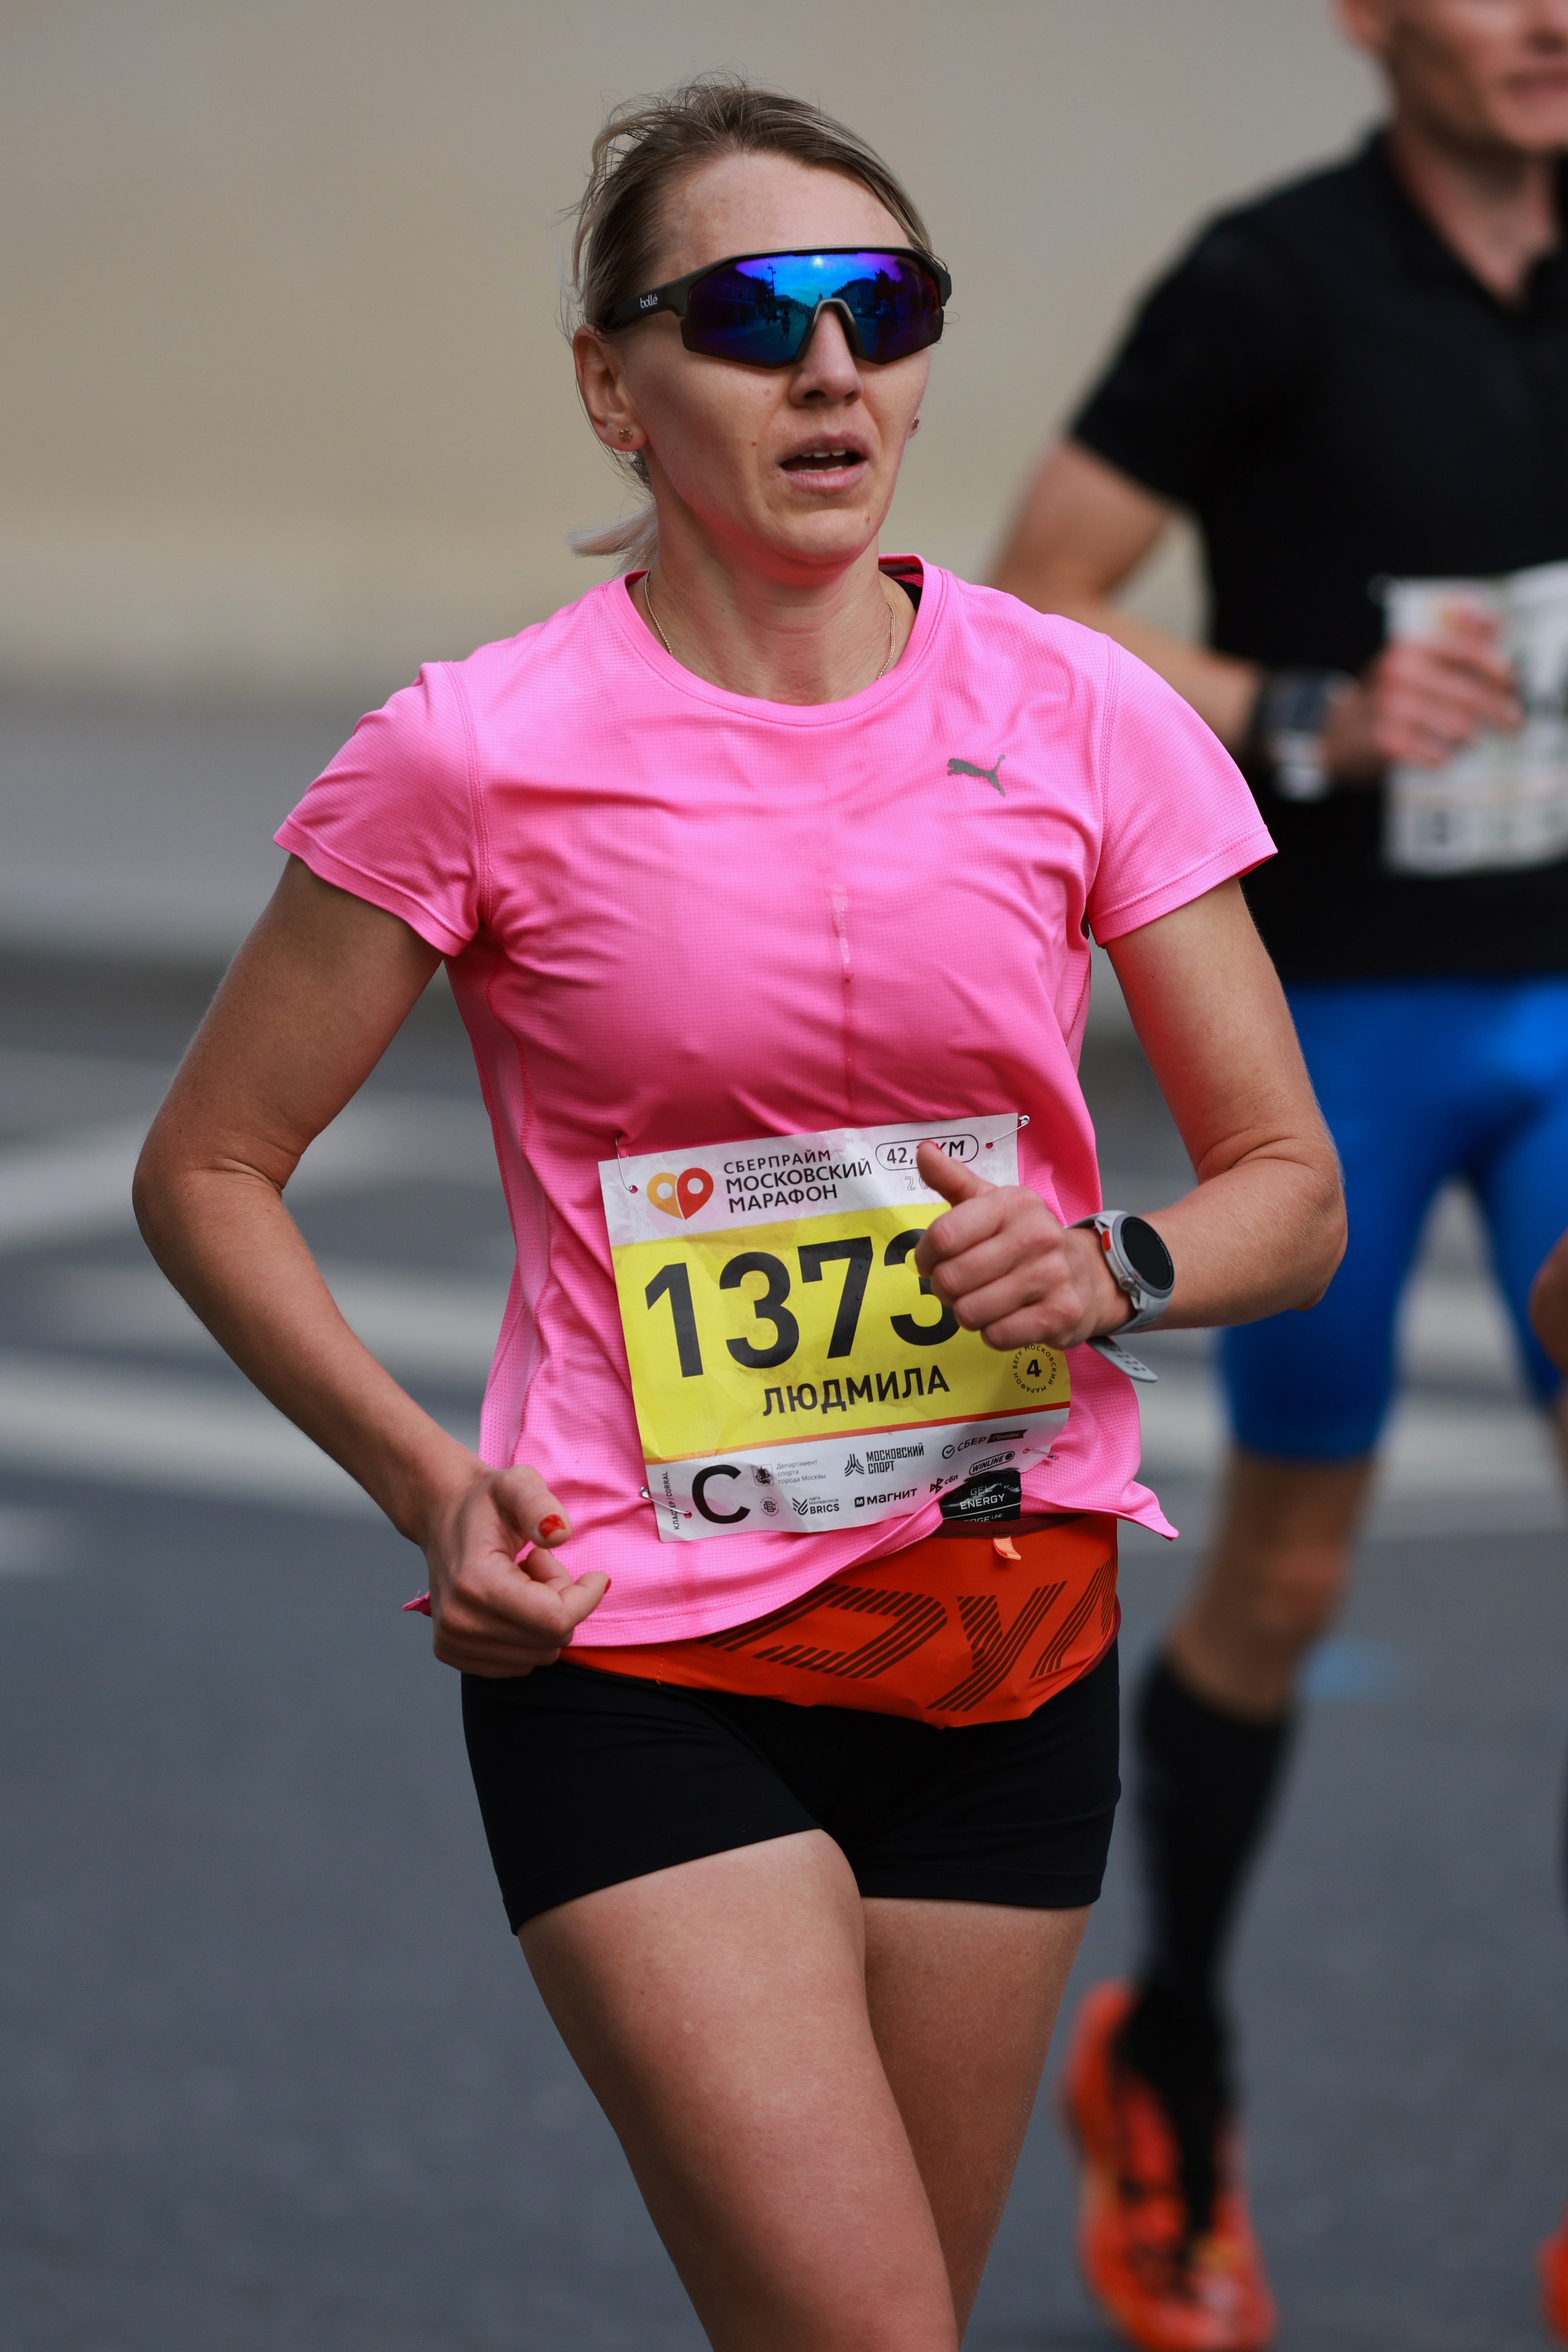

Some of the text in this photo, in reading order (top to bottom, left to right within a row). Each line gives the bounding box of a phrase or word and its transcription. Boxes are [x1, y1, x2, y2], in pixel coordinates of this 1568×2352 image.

[723, 1149, 831, 1174] СБЕРПРАЙМ
[886, 1145, 919, 1165] 42,
[726, 1157, 873, 1194] МОСКОВСКИЙ
[729, 1184, 838, 1213] МАРАФОН
[1024, 1344, 1057, 1385] МОСКОВСКИЙ
[1026, 1359, 1042, 1378] 4
[762, 1364, 950, 1417] ЛЮДМИЛА
[1013, 1373, 1046, 1393] МАРАФОН
[866, 1442, 924, 1463] МОСКОВСКИЙ
[957, 1436, 987, 1452] СБЕР
[776, 1460, 818, 1470] Департамент
[868, 1461, 894, 1474] СПОРТ
[972, 1455, 1005, 1473] WINLINE
[662, 1471, 673, 1497] CORRAL
[970, 1485, 993, 1496] GEL
[810, 1503, 840, 1514] BRICS
[960, 1493, 1005, 1510] ENERGY
